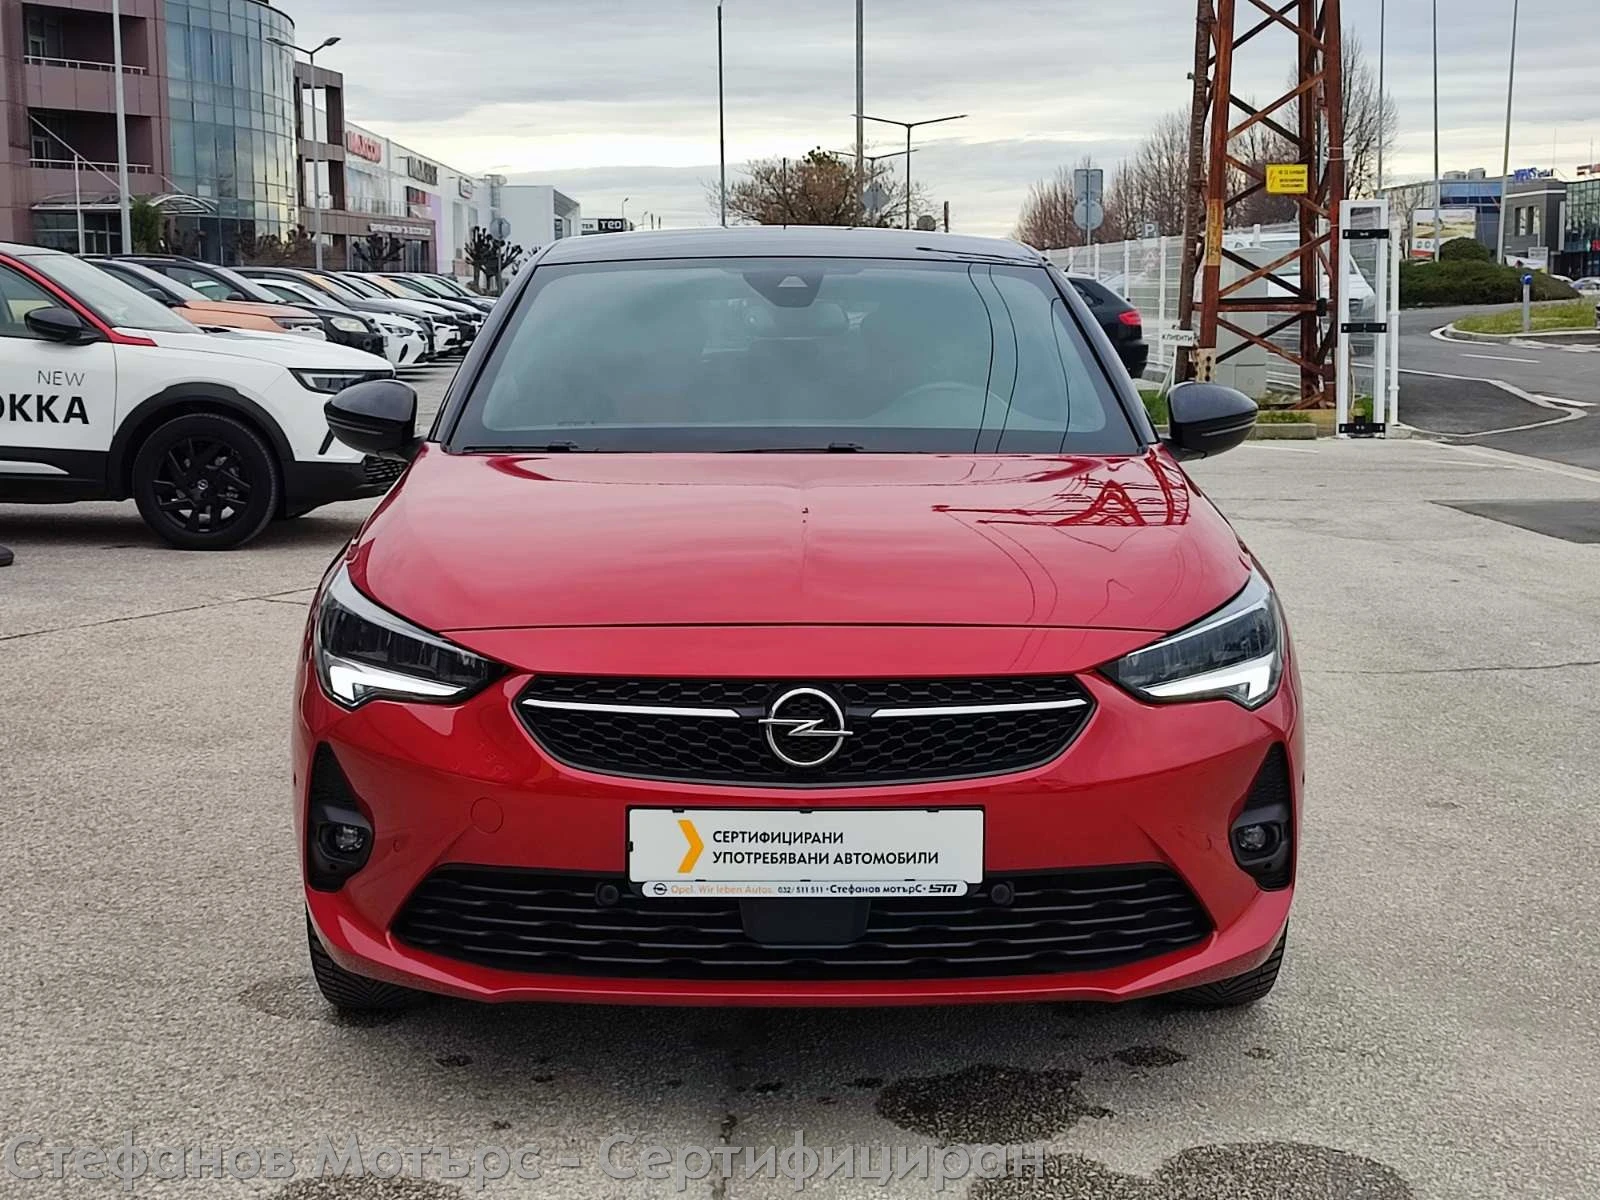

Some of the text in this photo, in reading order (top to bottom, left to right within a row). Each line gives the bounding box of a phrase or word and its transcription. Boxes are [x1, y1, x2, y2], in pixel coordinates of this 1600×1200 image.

[38, 370, 85, 386] NEW
[0, 393, 89, 424] KKA
[712, 831, 844, 845] СЕРТИФИЦИРАНИ
[712, 852, 939, 864] УПОТРЕБЯВАНИ АВТОМОБИЛИ
